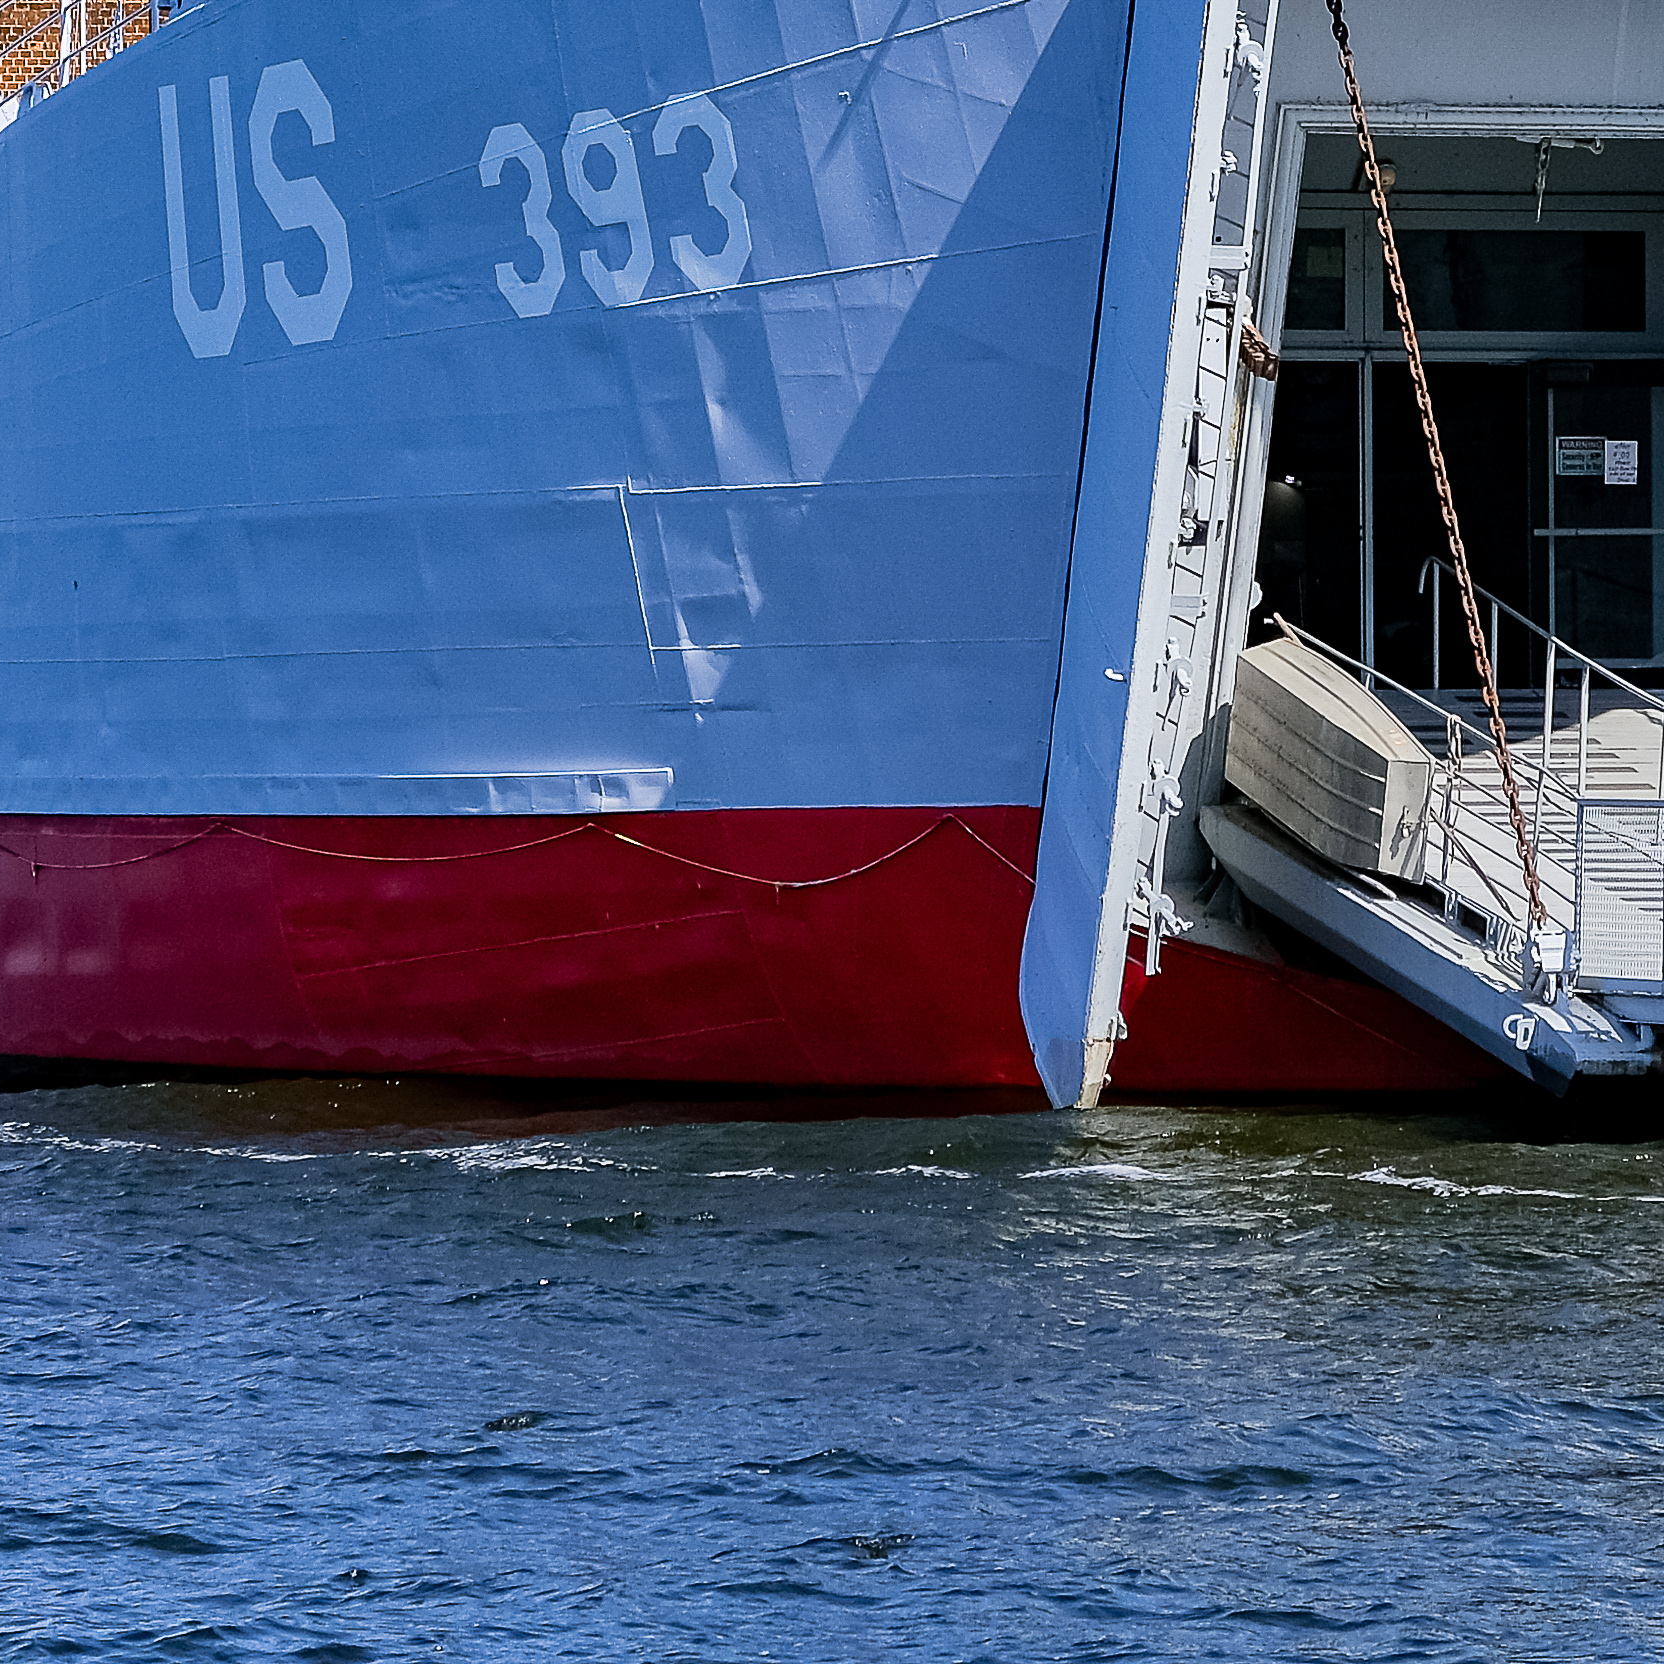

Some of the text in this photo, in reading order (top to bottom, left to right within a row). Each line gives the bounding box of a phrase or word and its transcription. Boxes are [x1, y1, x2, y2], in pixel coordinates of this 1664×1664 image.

[157, 58, 753, 359] US 393
[1561, 440, 1603, 449] WARNING
